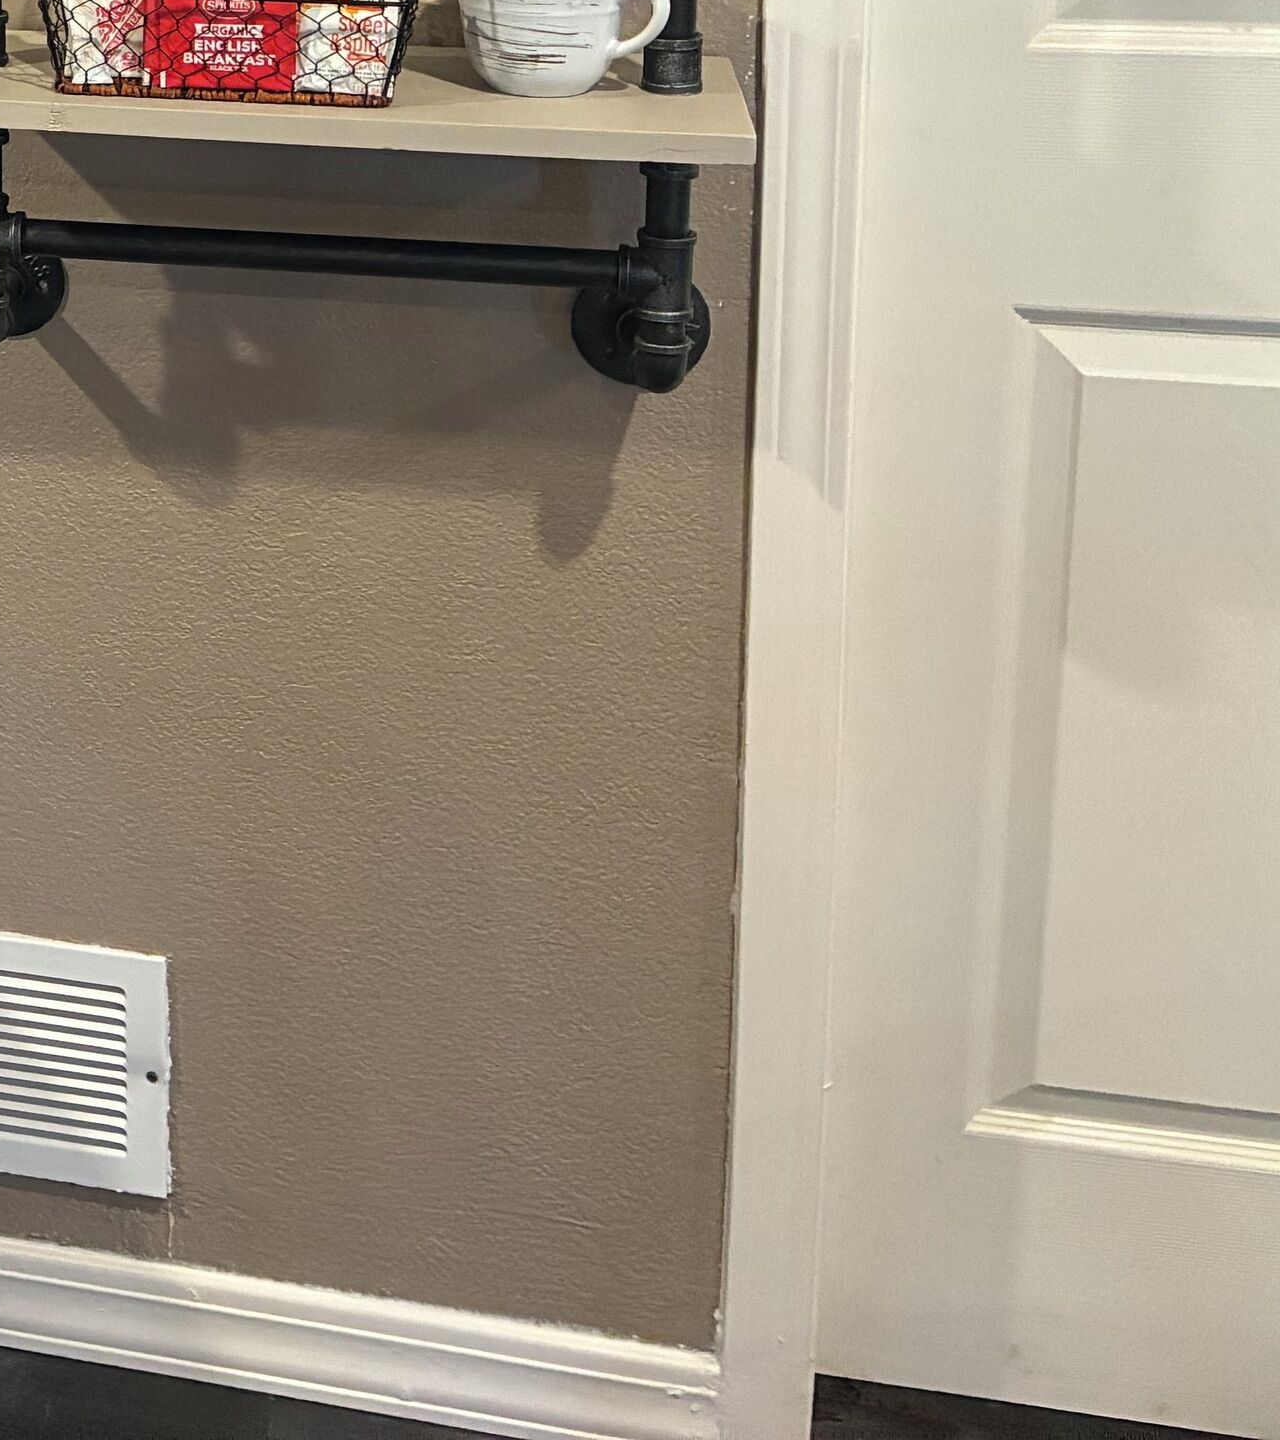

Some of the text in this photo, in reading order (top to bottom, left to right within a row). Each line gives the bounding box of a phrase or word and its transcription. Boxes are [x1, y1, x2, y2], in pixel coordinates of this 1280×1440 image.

[201, 24, 258, 36] ORGANIC
[194, 39, 262, 53] ENGLISH
[183, 52, 276, 67] BREAKFAST
